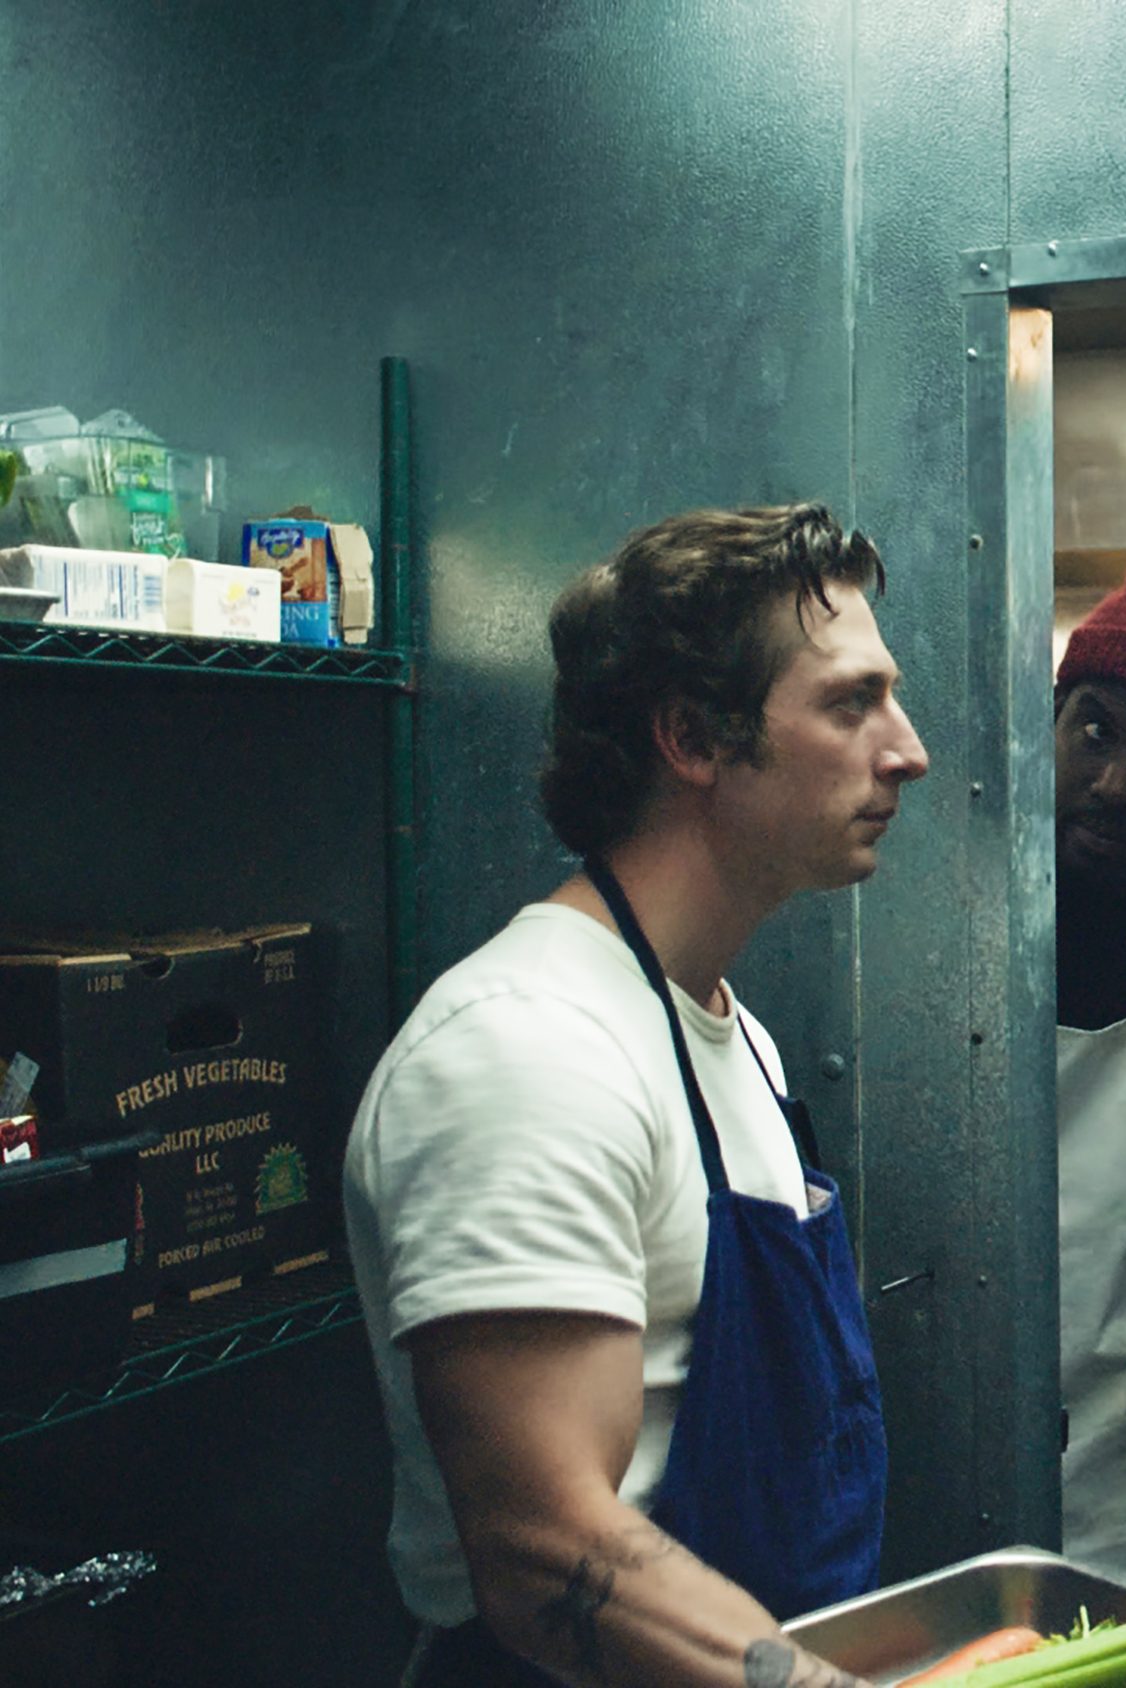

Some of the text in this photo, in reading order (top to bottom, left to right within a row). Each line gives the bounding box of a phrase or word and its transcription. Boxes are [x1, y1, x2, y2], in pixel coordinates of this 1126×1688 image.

[115, 1058, 288, 1117] FRESH VEGETABLES
[205, 1111, 272, 1146] PRODUCE
[195, 1151, 221, 1175] LLC
